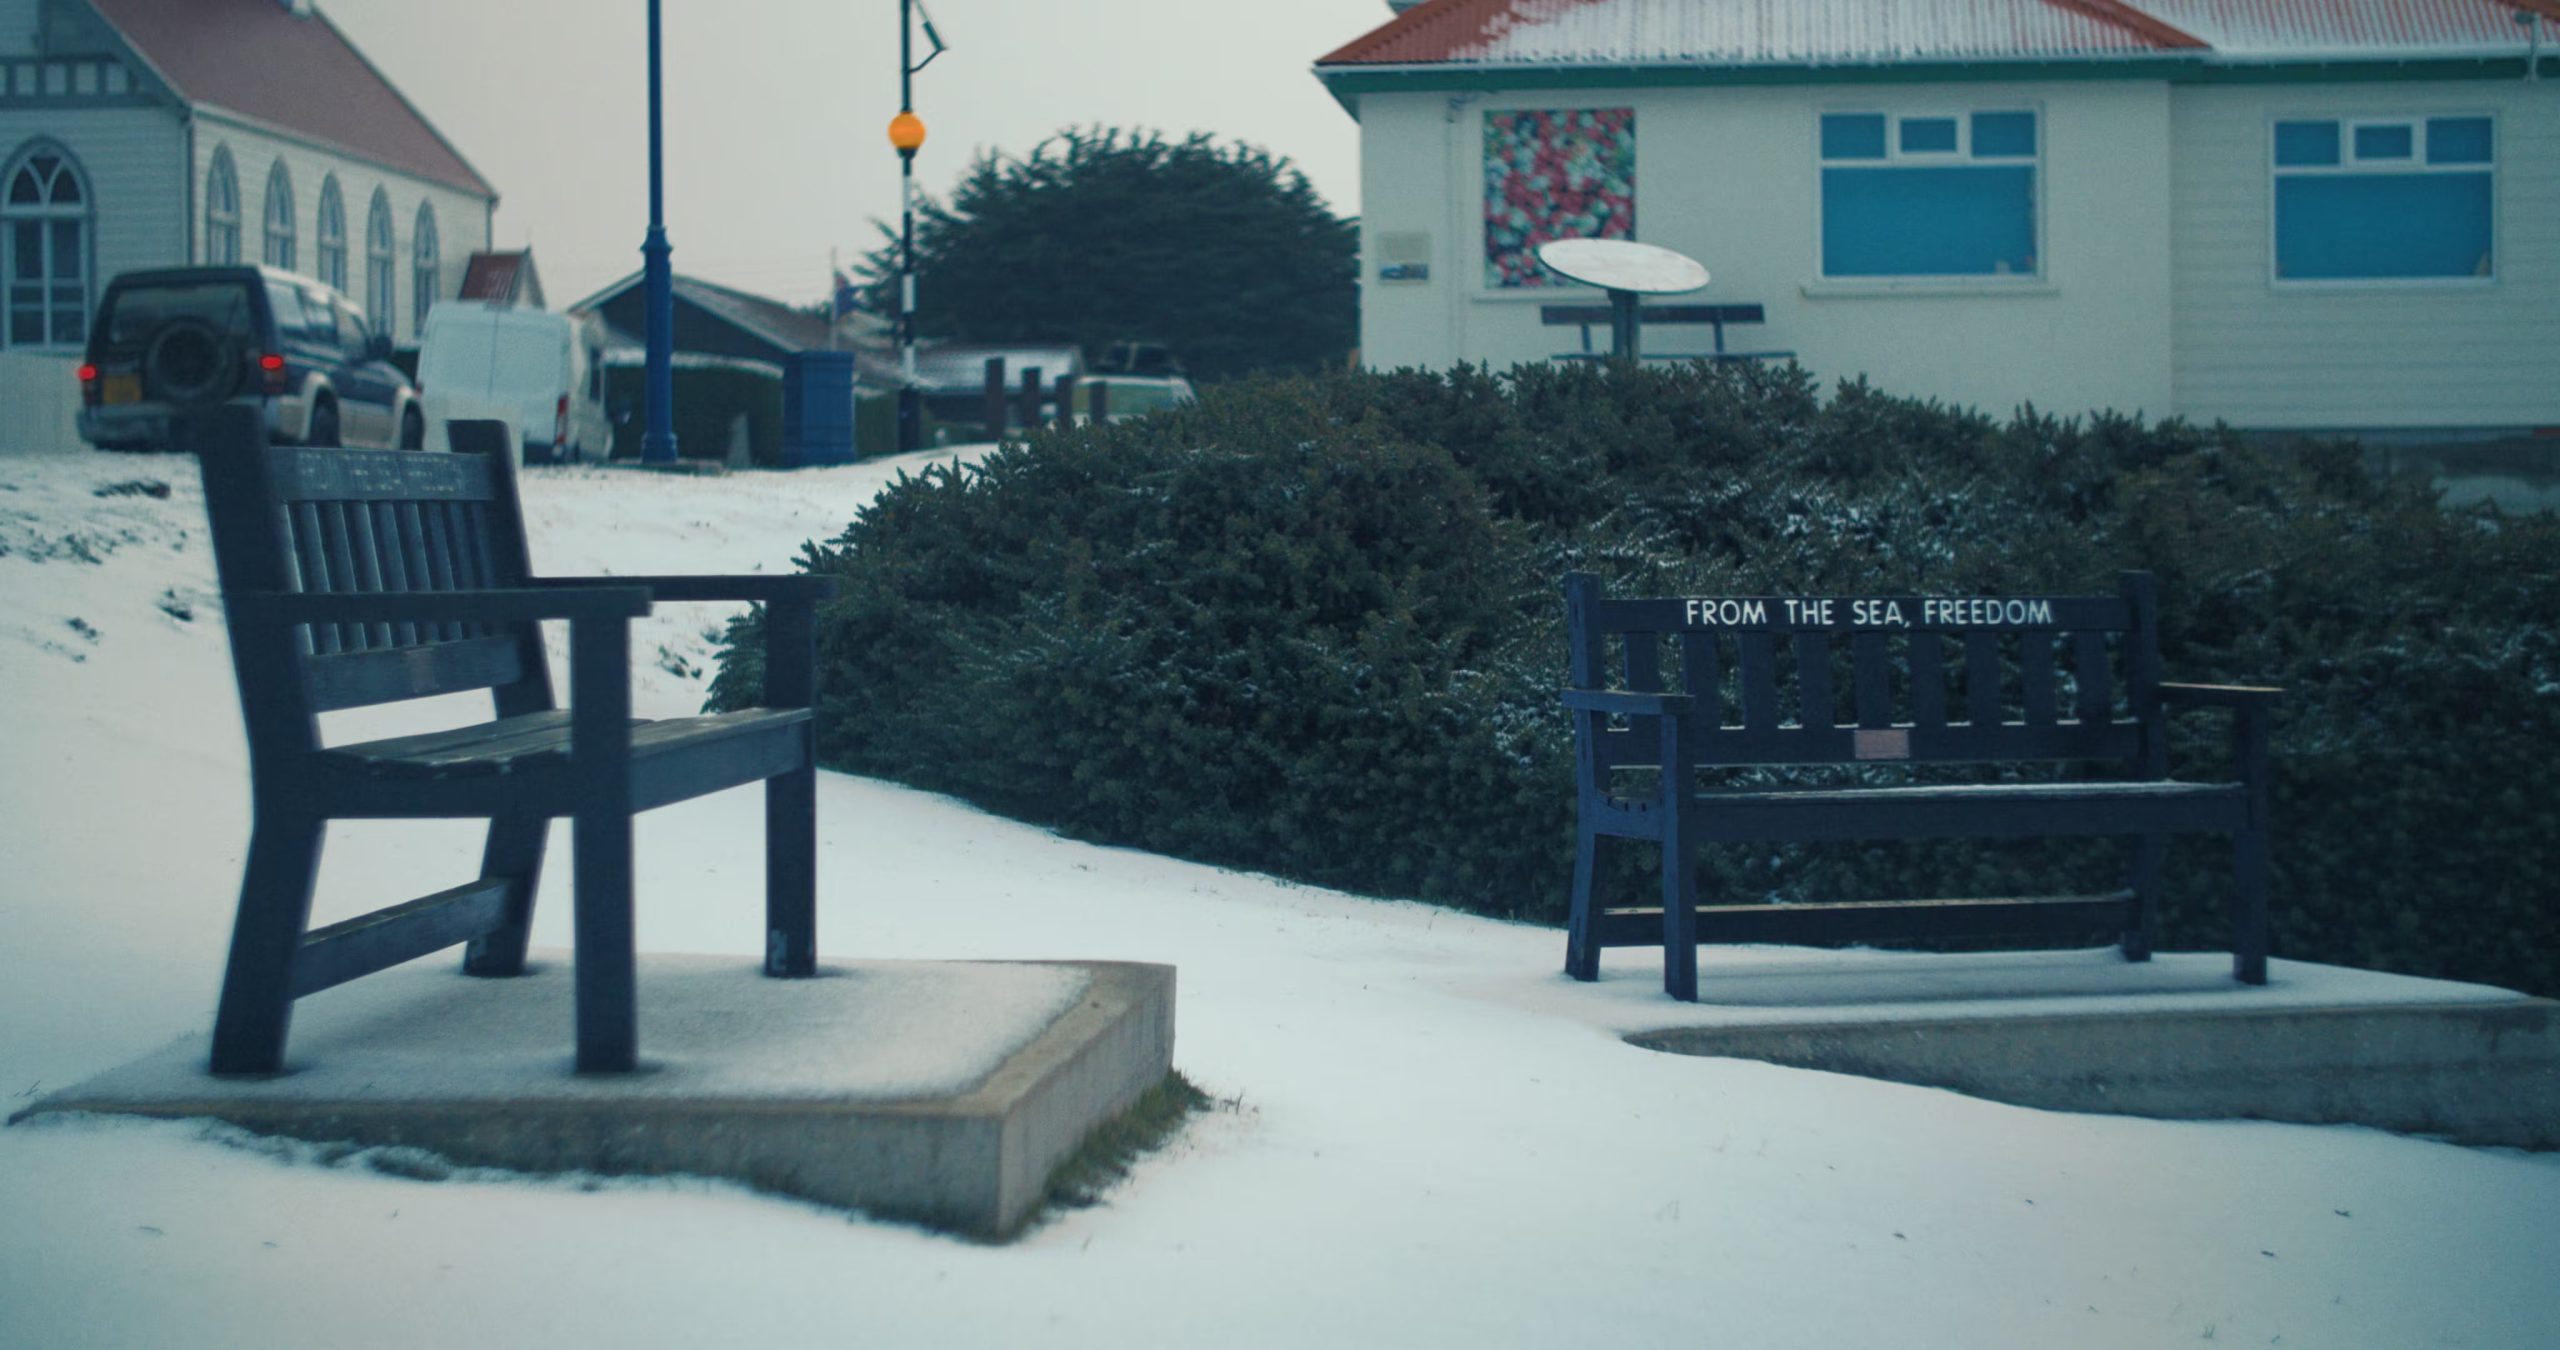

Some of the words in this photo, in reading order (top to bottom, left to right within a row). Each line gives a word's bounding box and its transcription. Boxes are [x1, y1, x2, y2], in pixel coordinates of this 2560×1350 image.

[1686, 599, 1768, 625] FROM
[1784, 599, 1835, 625] THE
[1852, 599, 1911, 629] SEA,
[1924, 599, 2053, 625] FREEDOM
